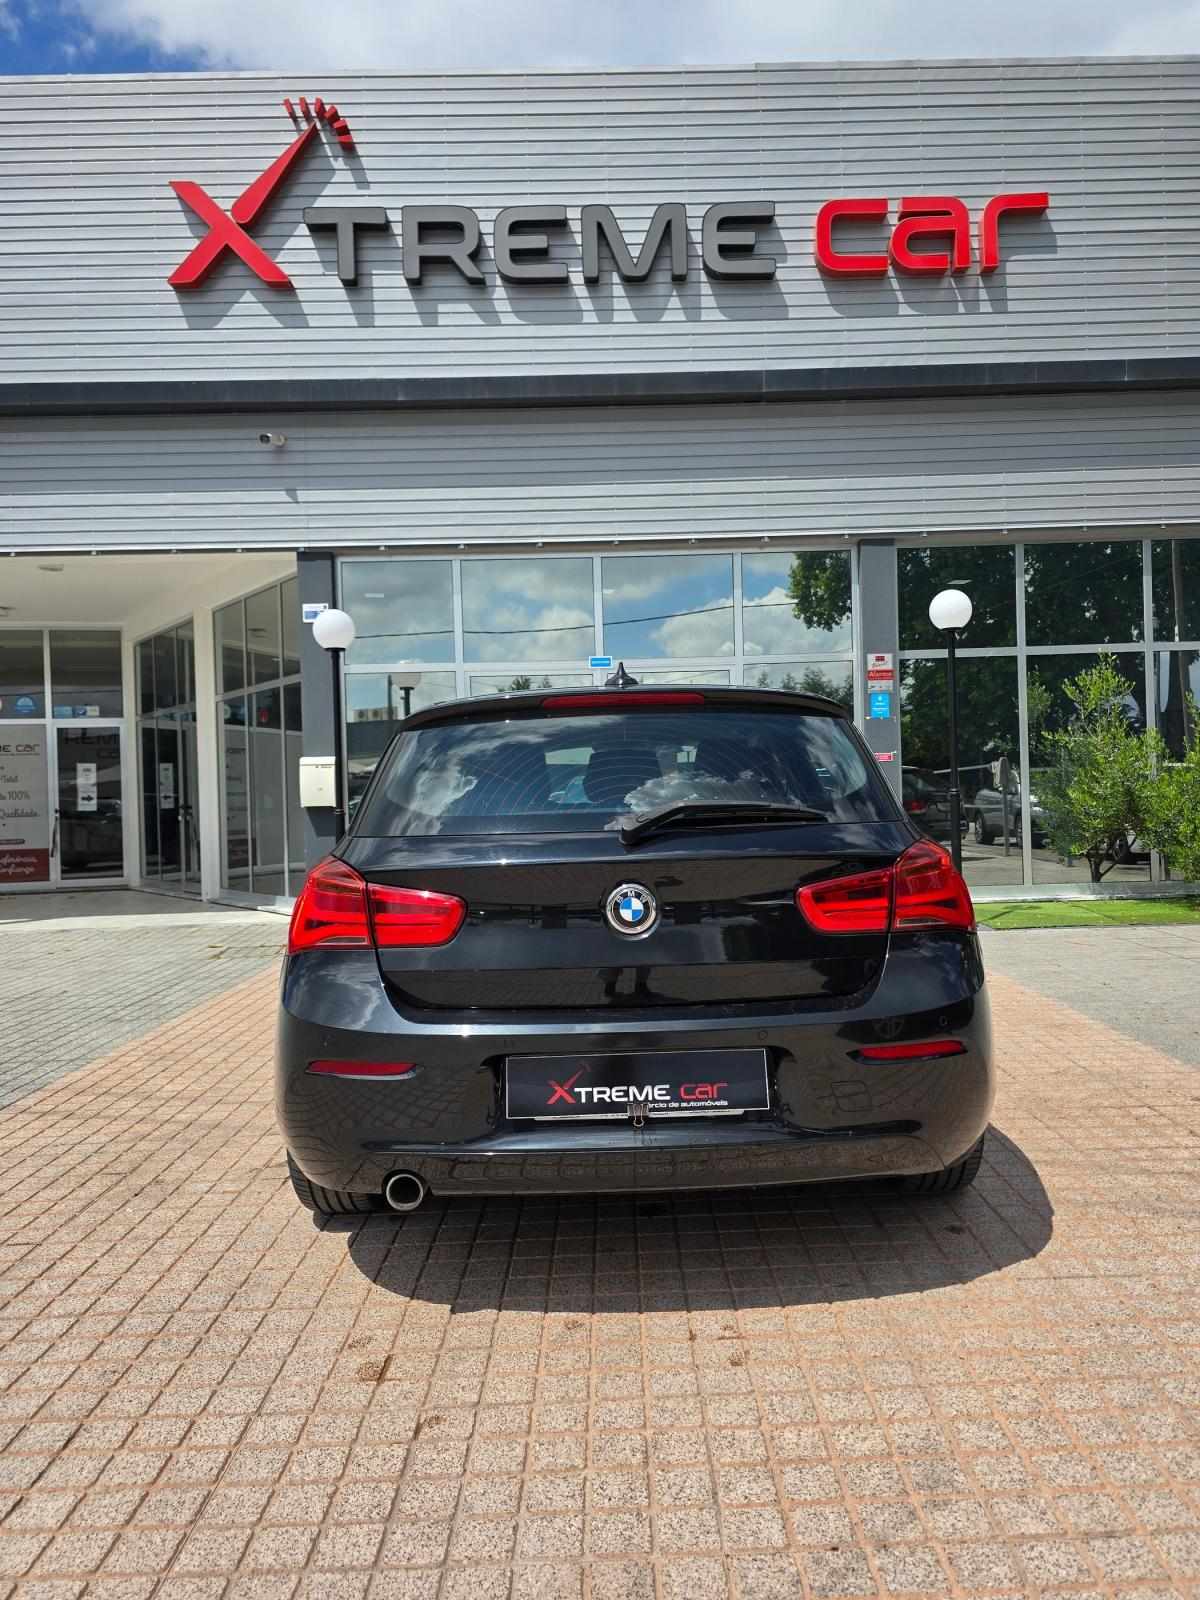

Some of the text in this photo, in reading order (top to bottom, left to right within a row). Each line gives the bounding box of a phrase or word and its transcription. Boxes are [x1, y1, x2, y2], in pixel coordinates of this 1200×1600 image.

[168, 97, 1050, 291] XTREME car
[615, 890, 649, 904] BMW
[546, 1062, 729, 1105] XTREME car
[680, 1099, 729, 1108] automóveis
